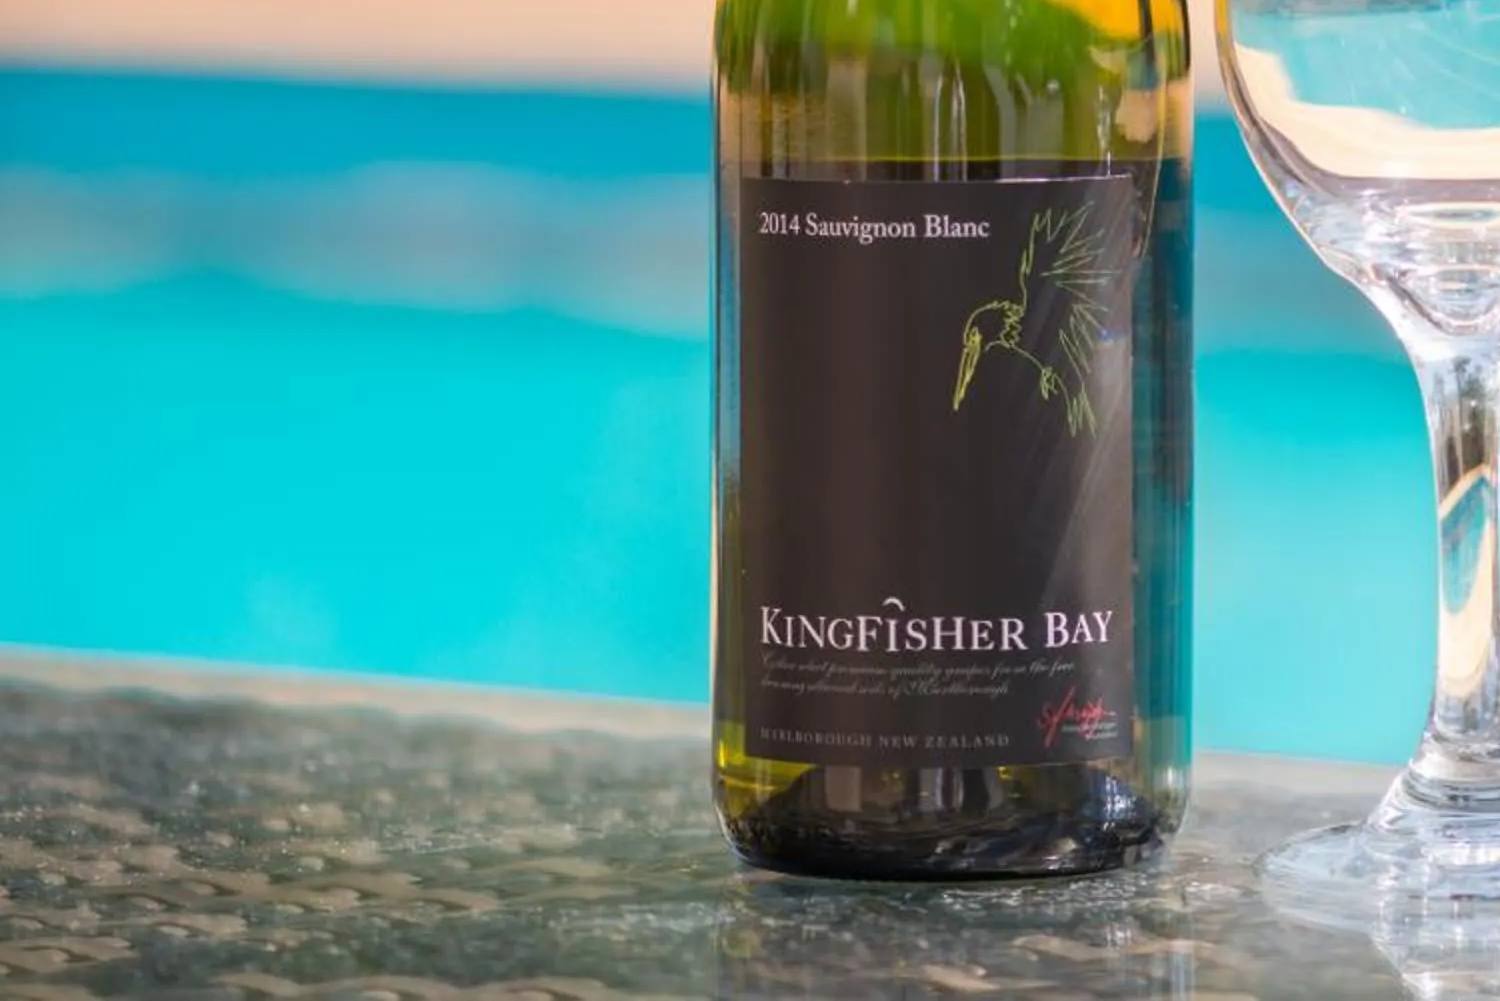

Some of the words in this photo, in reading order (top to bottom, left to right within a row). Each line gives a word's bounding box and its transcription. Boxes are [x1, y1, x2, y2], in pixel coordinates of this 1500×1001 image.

[759, 211, 801, 236] 2014
[804, 212, 917, 245] Sauvignon
[923, 213, 990, 239] Blanc
[760, 597, 1029, 653] KINGFISHER
[1043, 609, 1114, 648] BAY
[879, 734, 918, 749] NEW
[924, 733, 1010, 750] ZEALAND
